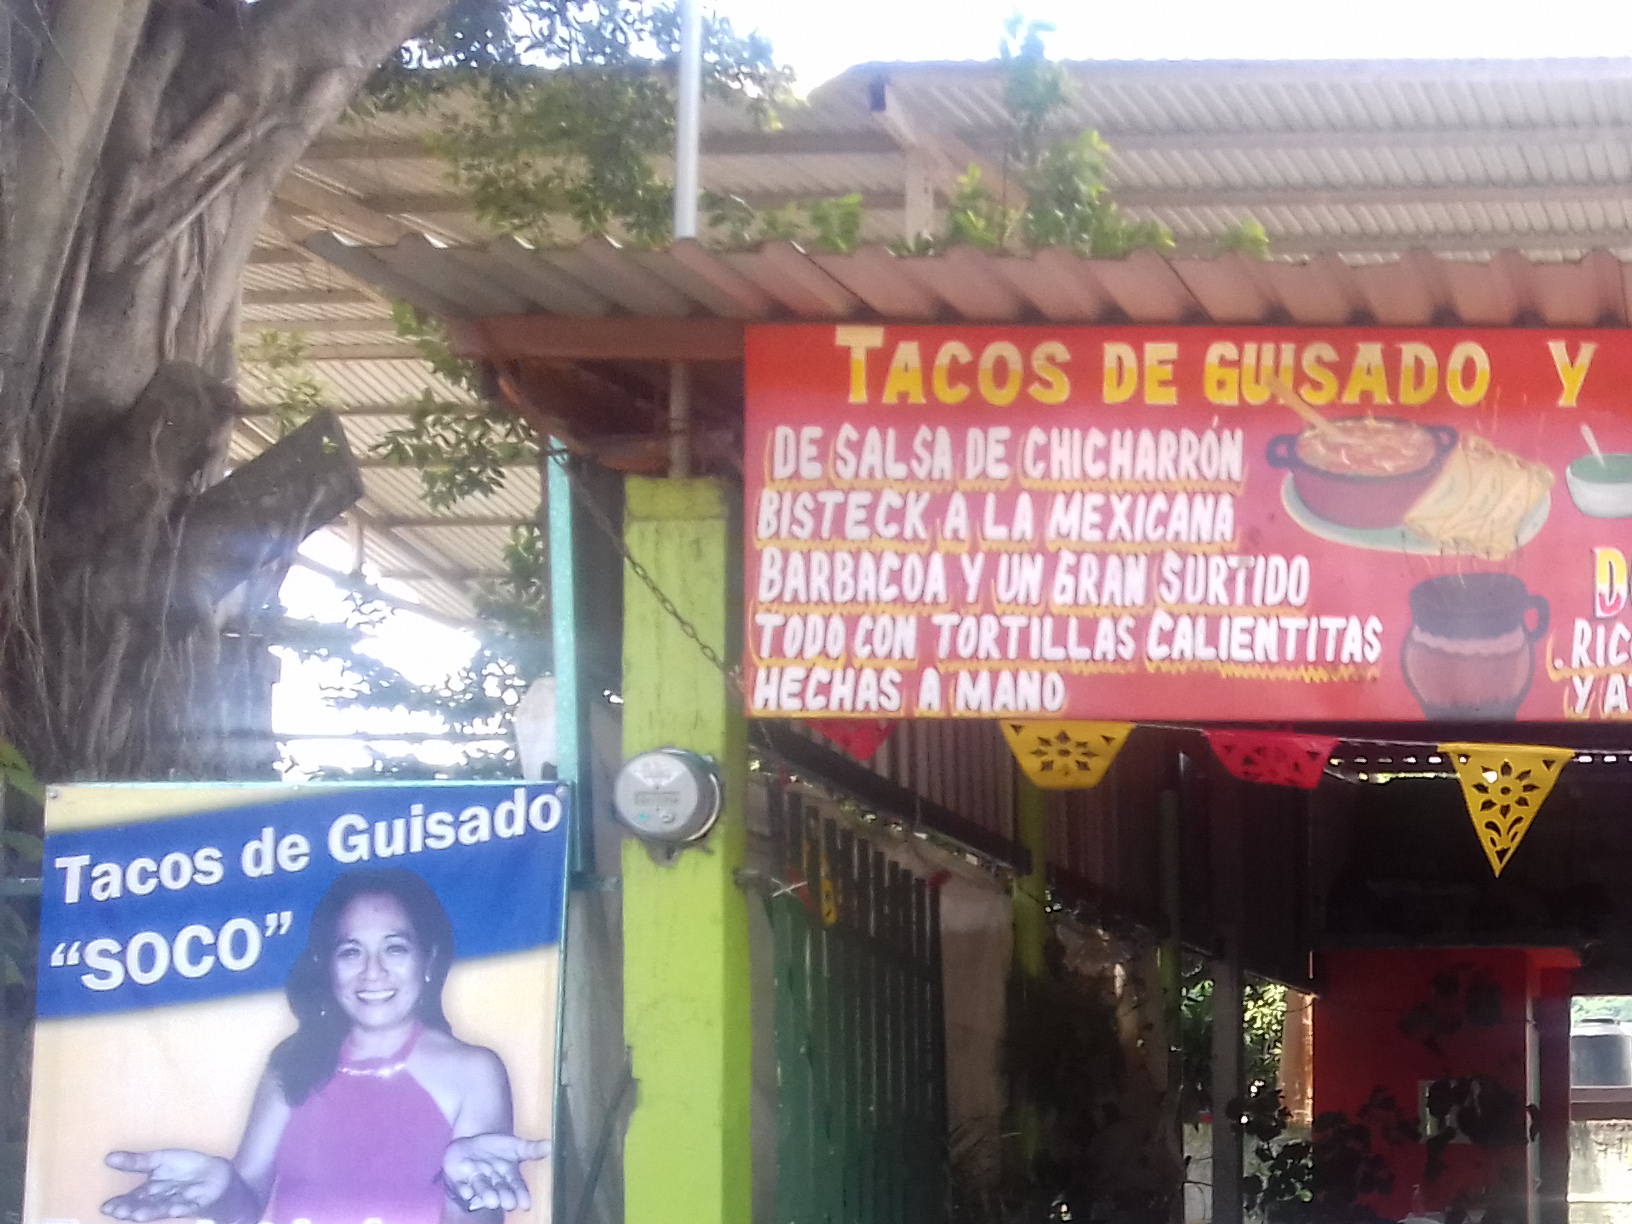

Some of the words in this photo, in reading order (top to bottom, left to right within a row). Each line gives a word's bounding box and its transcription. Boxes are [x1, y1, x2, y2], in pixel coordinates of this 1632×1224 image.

[835, 326, 1071, 405] TACOS
[1102, 341, 1179, 405] DE
[1202, 341, 1492, 406] GUISADO
[1549, 341, 1597, 407] Y
[773, 425, 823, 481] DE
[834, 422, 952, 482] SALSA
[965, 426, 1012, 481] DE
[757, 489, 931, 540] BISTECK
[943, 491, 968, 539] A
[983, 492, 1034, 541] LA
[1049, 491, 1234, 543] MEXICANA
[757, 546, 947, 602] BARBACOA
[961, 552, 985, 603] Y
[997, 552, 1044, 603] UN
[1052, 550, 1148, 604] GRAN
[1158, 551, 1310, 606] SURTIDO
[755, 612, 846, 659] TODO
[854, 613, 917, 659] CON
[931, 613, 1135, 661] TORTILLAS
[1147, 609, 1383, 663] CALIENTITAS
[754, 666, 902, 711] HECHAS
[918, 667, 941, 711] A
[955, 669, 1066, 712] MANO
[1572, 673, 1594, 714] Y
[55, 844, 224, 904] Tacos
[241, 827, 310, 878] de
[327, 789, 562, 864] Guisado
